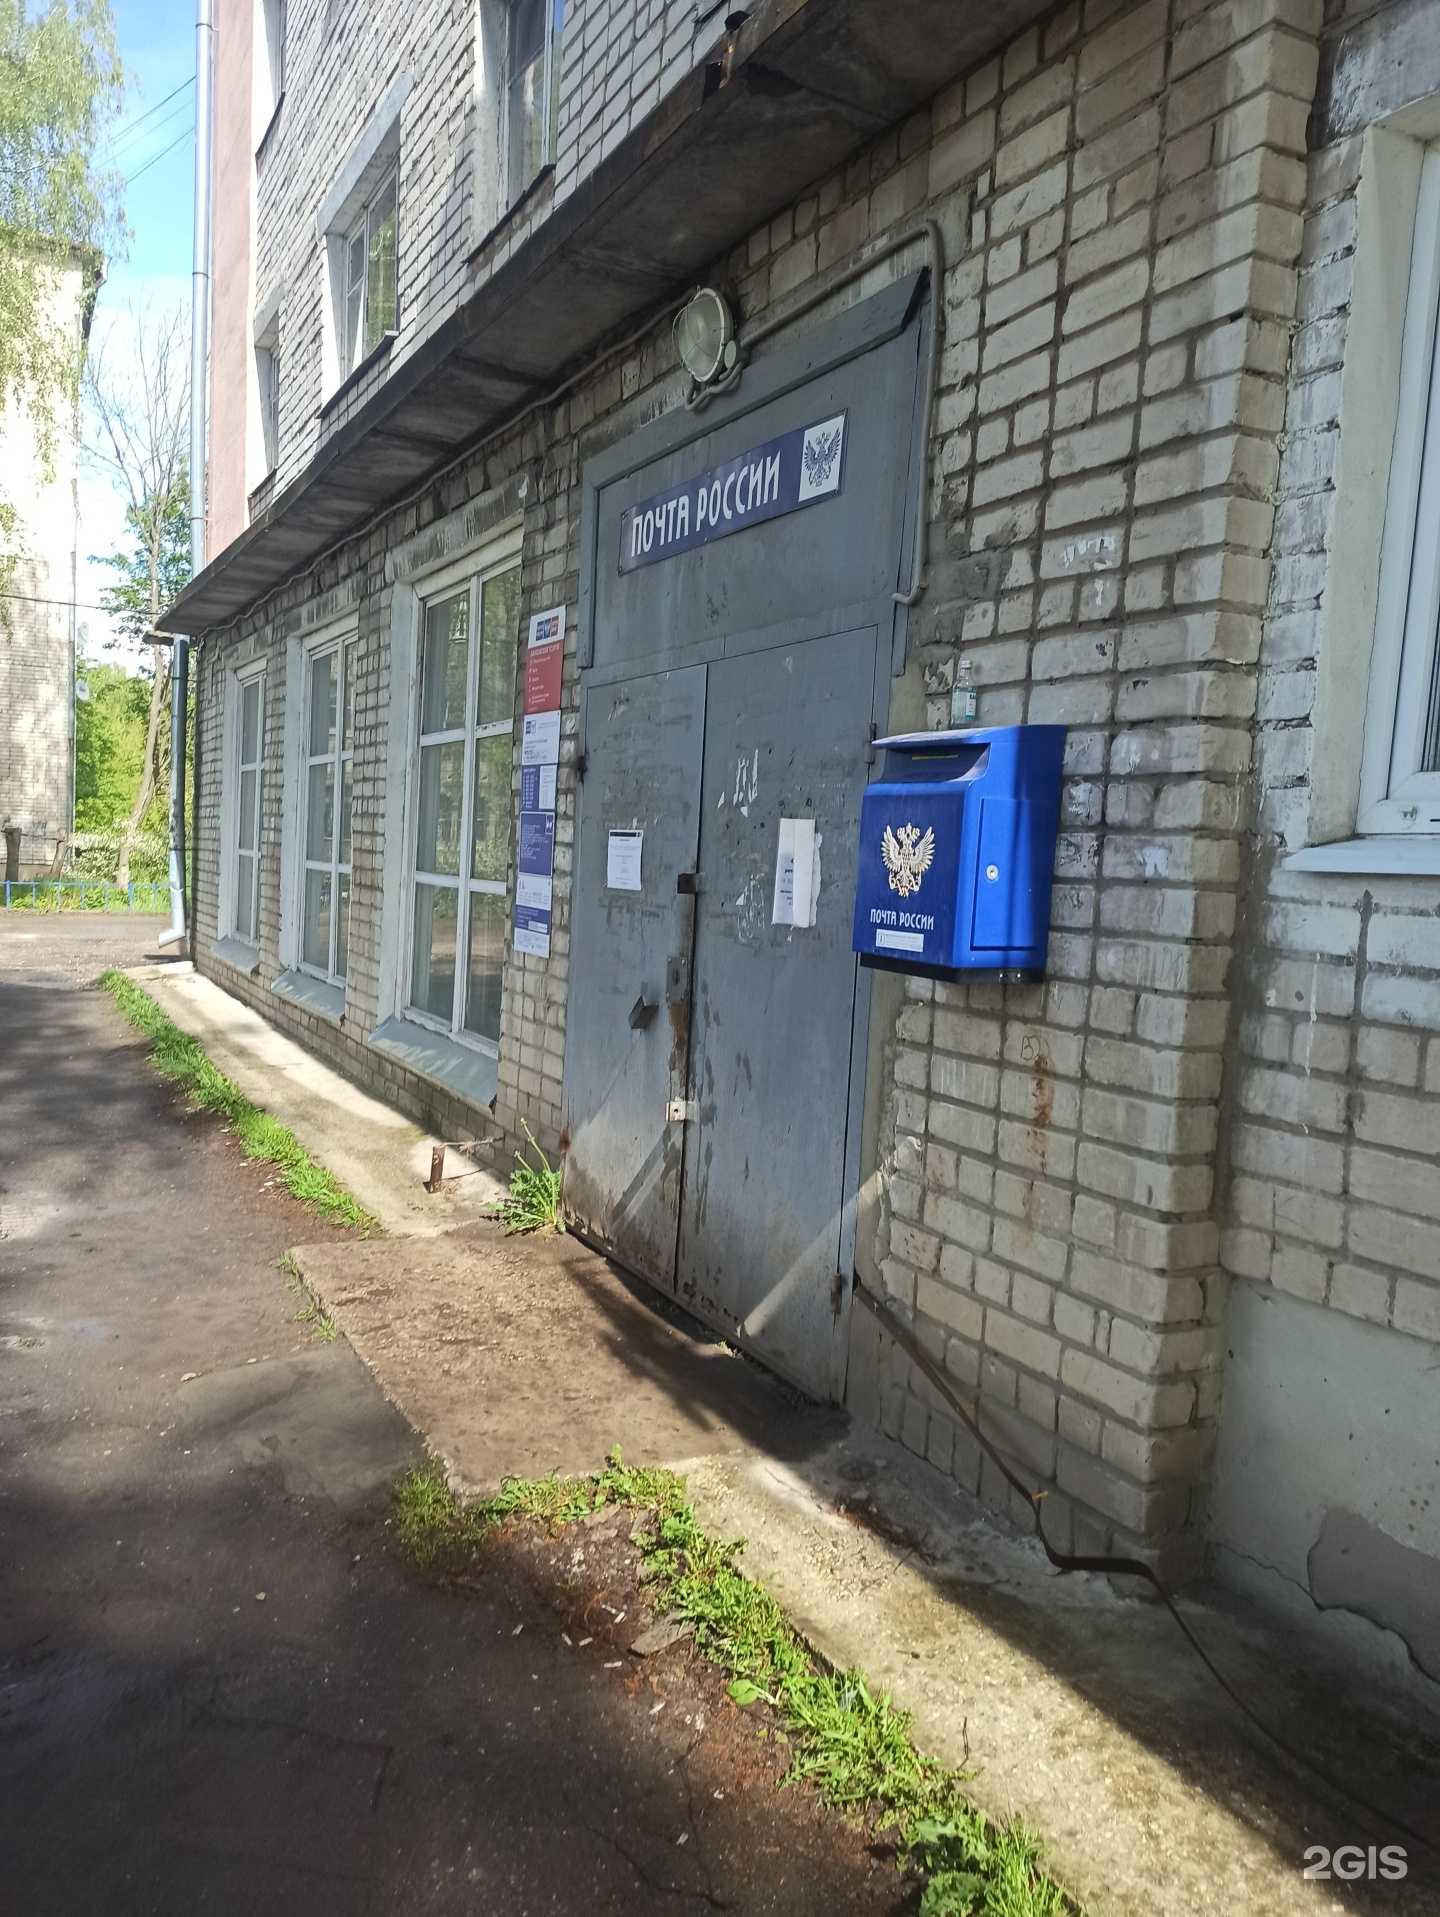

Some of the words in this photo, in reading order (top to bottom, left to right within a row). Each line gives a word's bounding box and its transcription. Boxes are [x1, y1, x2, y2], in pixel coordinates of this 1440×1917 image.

[631, 495, 689, 557] ПОЧТА
[696, 450, 781, 532] РОССИИ
[870, 908, 897, 925] ПОЧТА
[899, 911, 935, 930] РОССИИ
